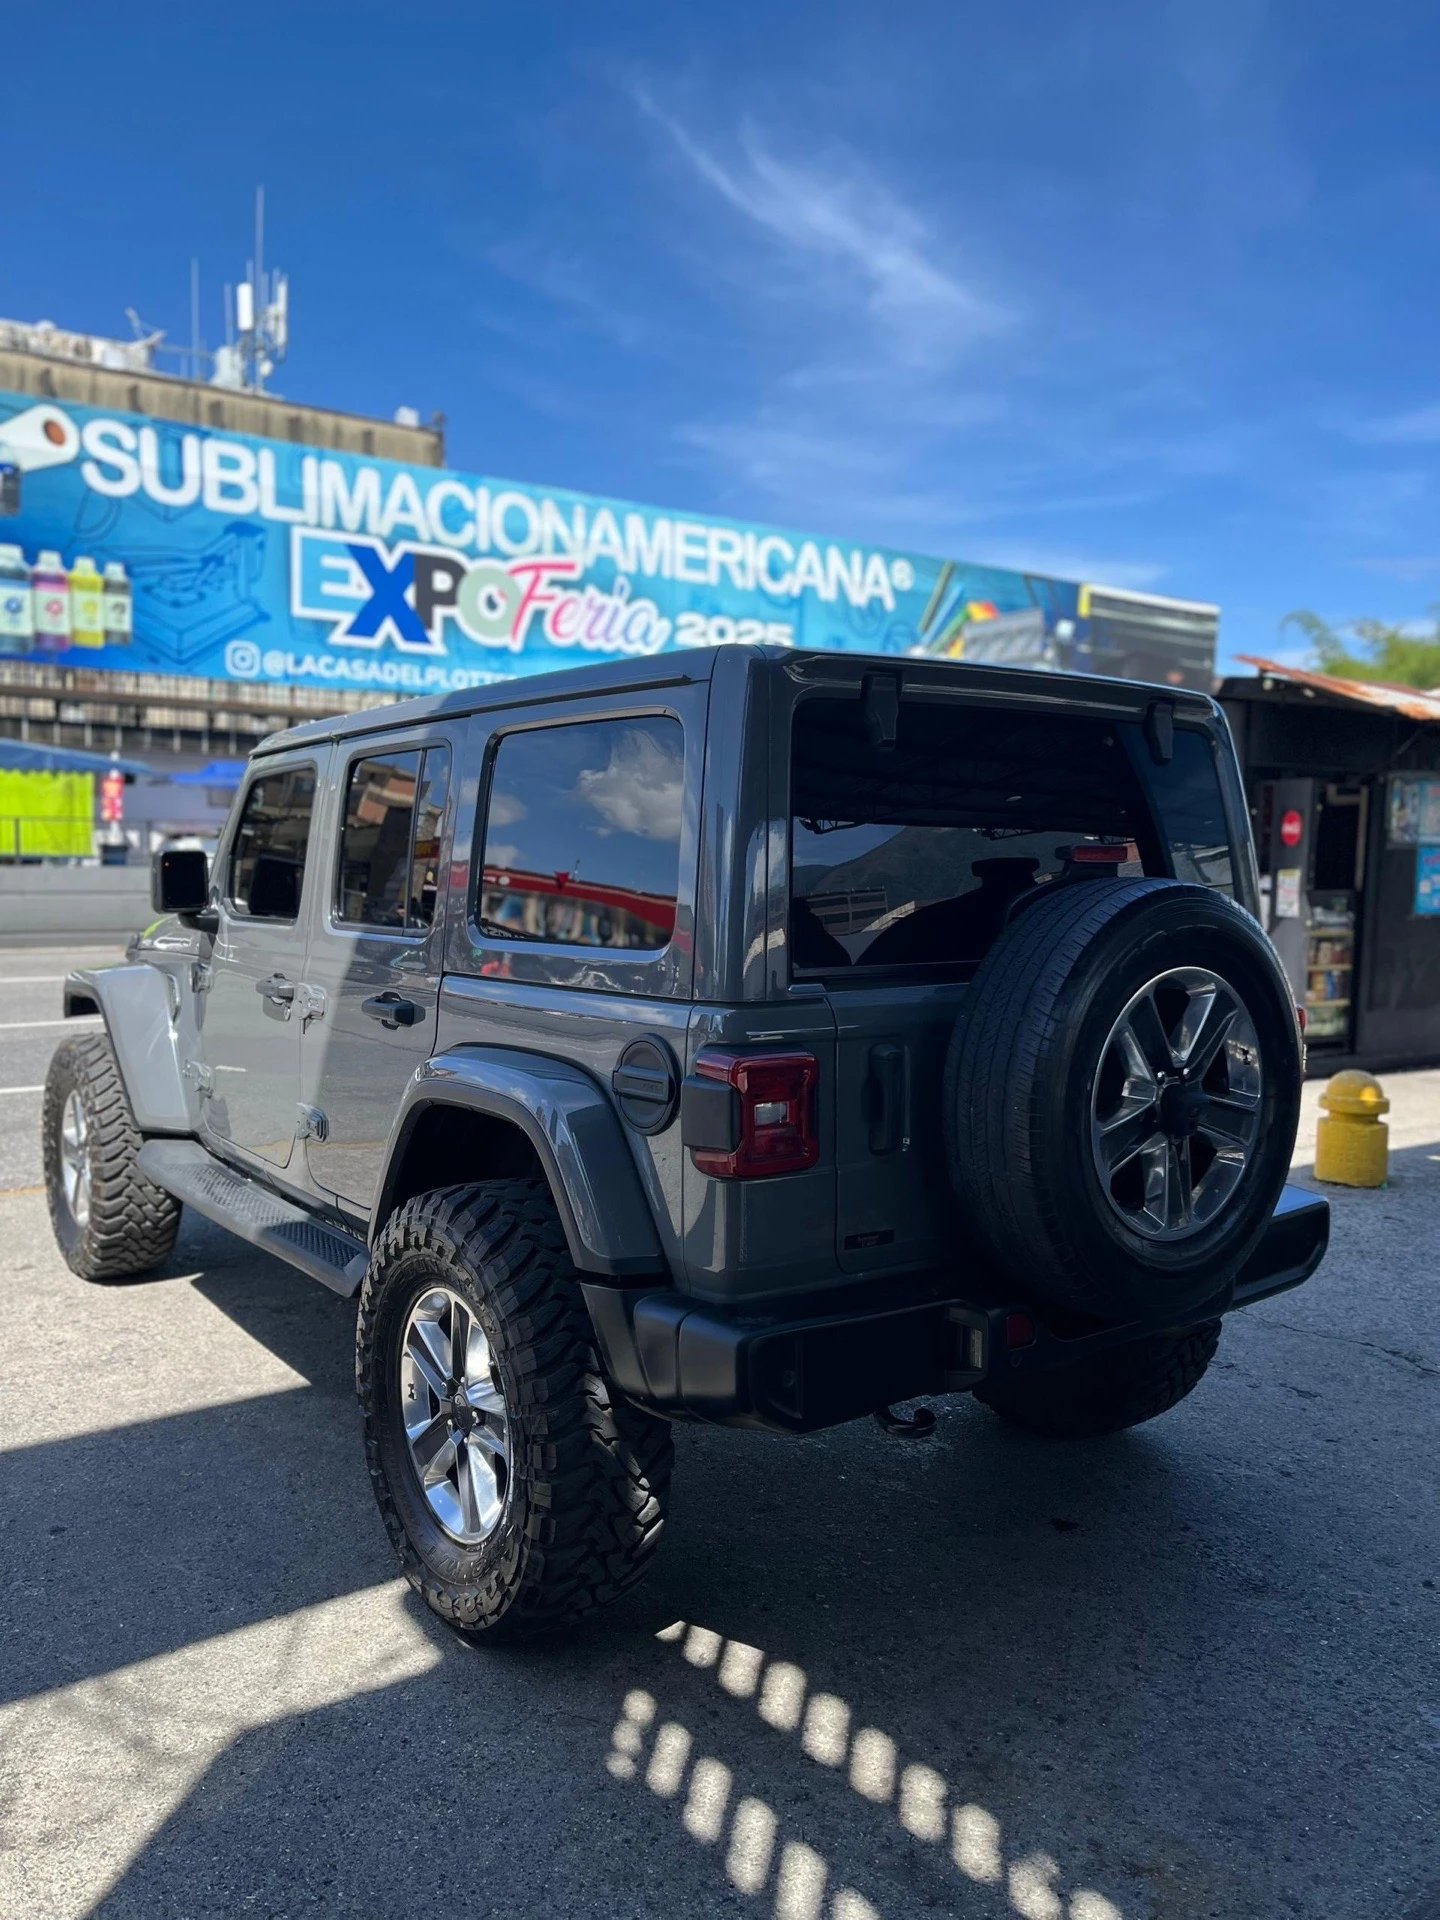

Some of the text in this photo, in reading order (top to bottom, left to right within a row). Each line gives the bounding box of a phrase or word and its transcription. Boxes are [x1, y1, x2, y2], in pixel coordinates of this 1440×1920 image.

[291, 526, 795, 654] EXPO Feria 2025
